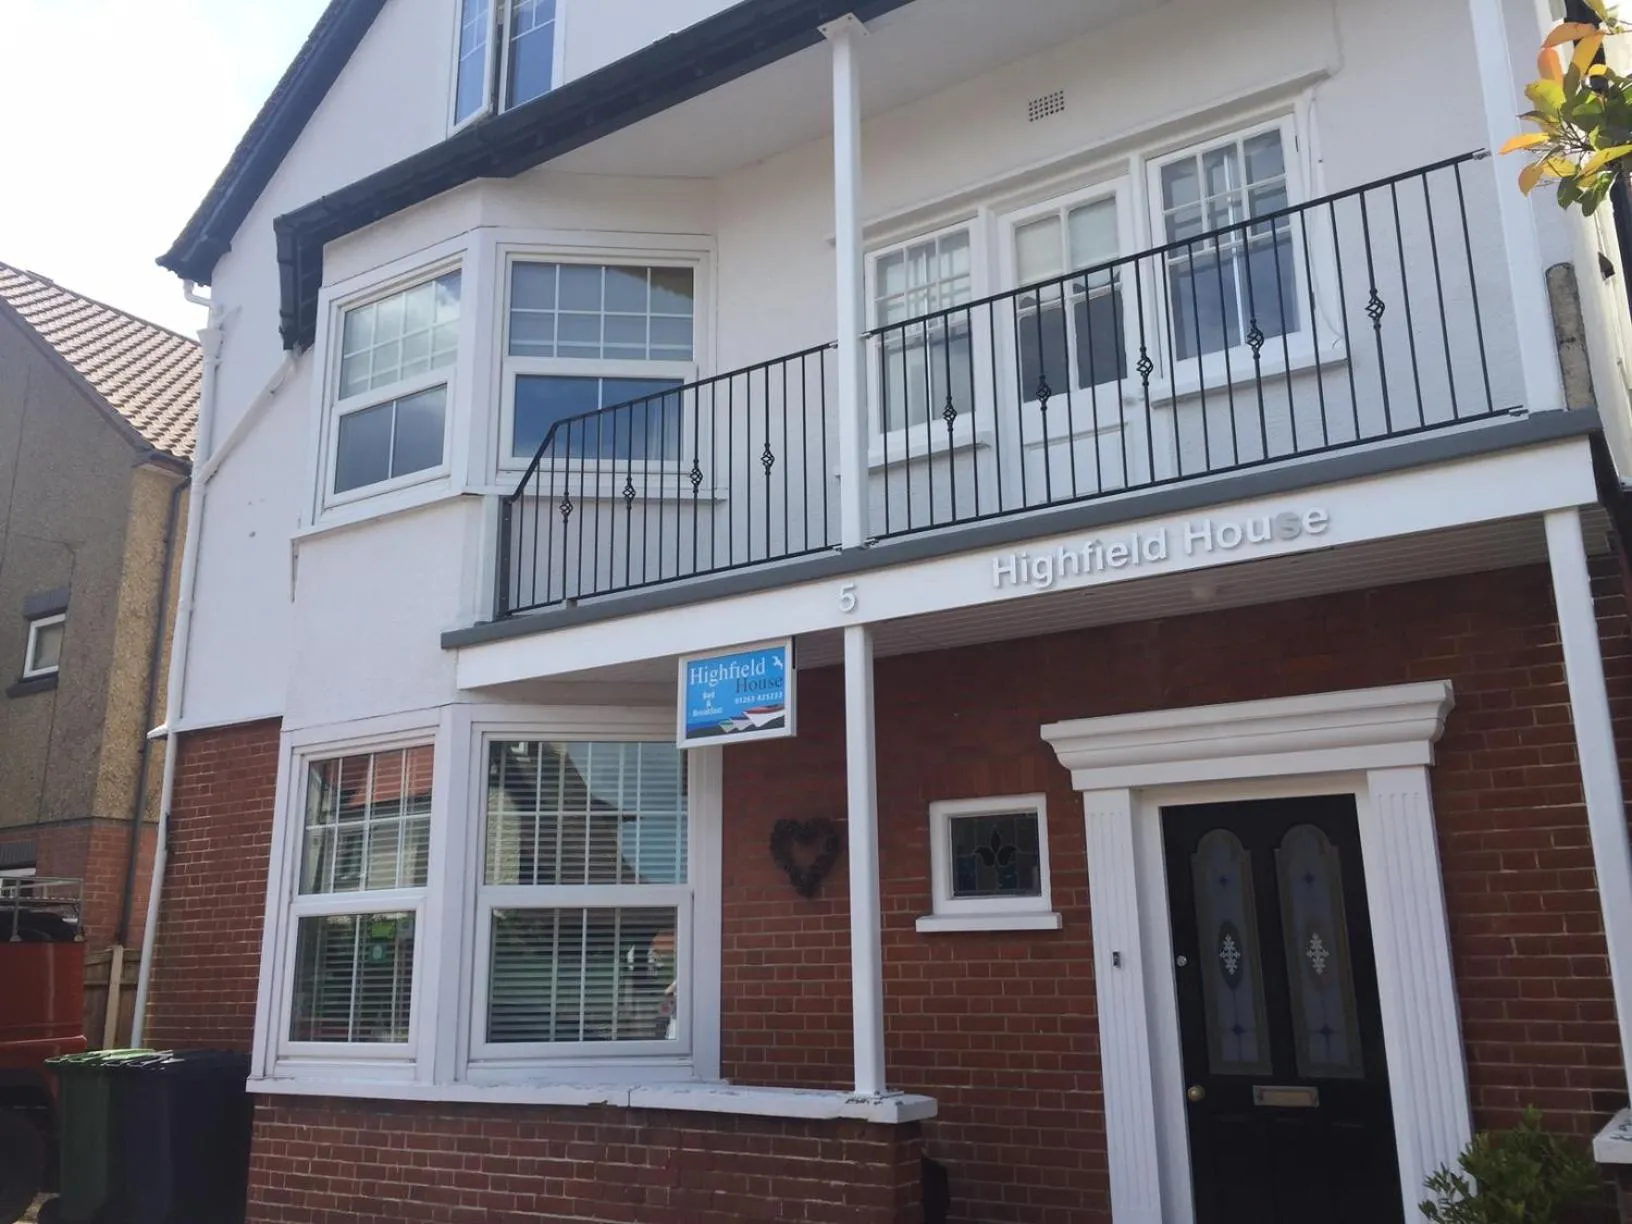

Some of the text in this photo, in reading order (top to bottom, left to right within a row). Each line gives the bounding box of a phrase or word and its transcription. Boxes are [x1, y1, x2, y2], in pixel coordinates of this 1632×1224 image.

[992, 506, 1329, 589] Highfield House
[839, 581, 856, 612] 5
[690, 656, 766, 687] Highfield
[736, 676, 783, 693] House
